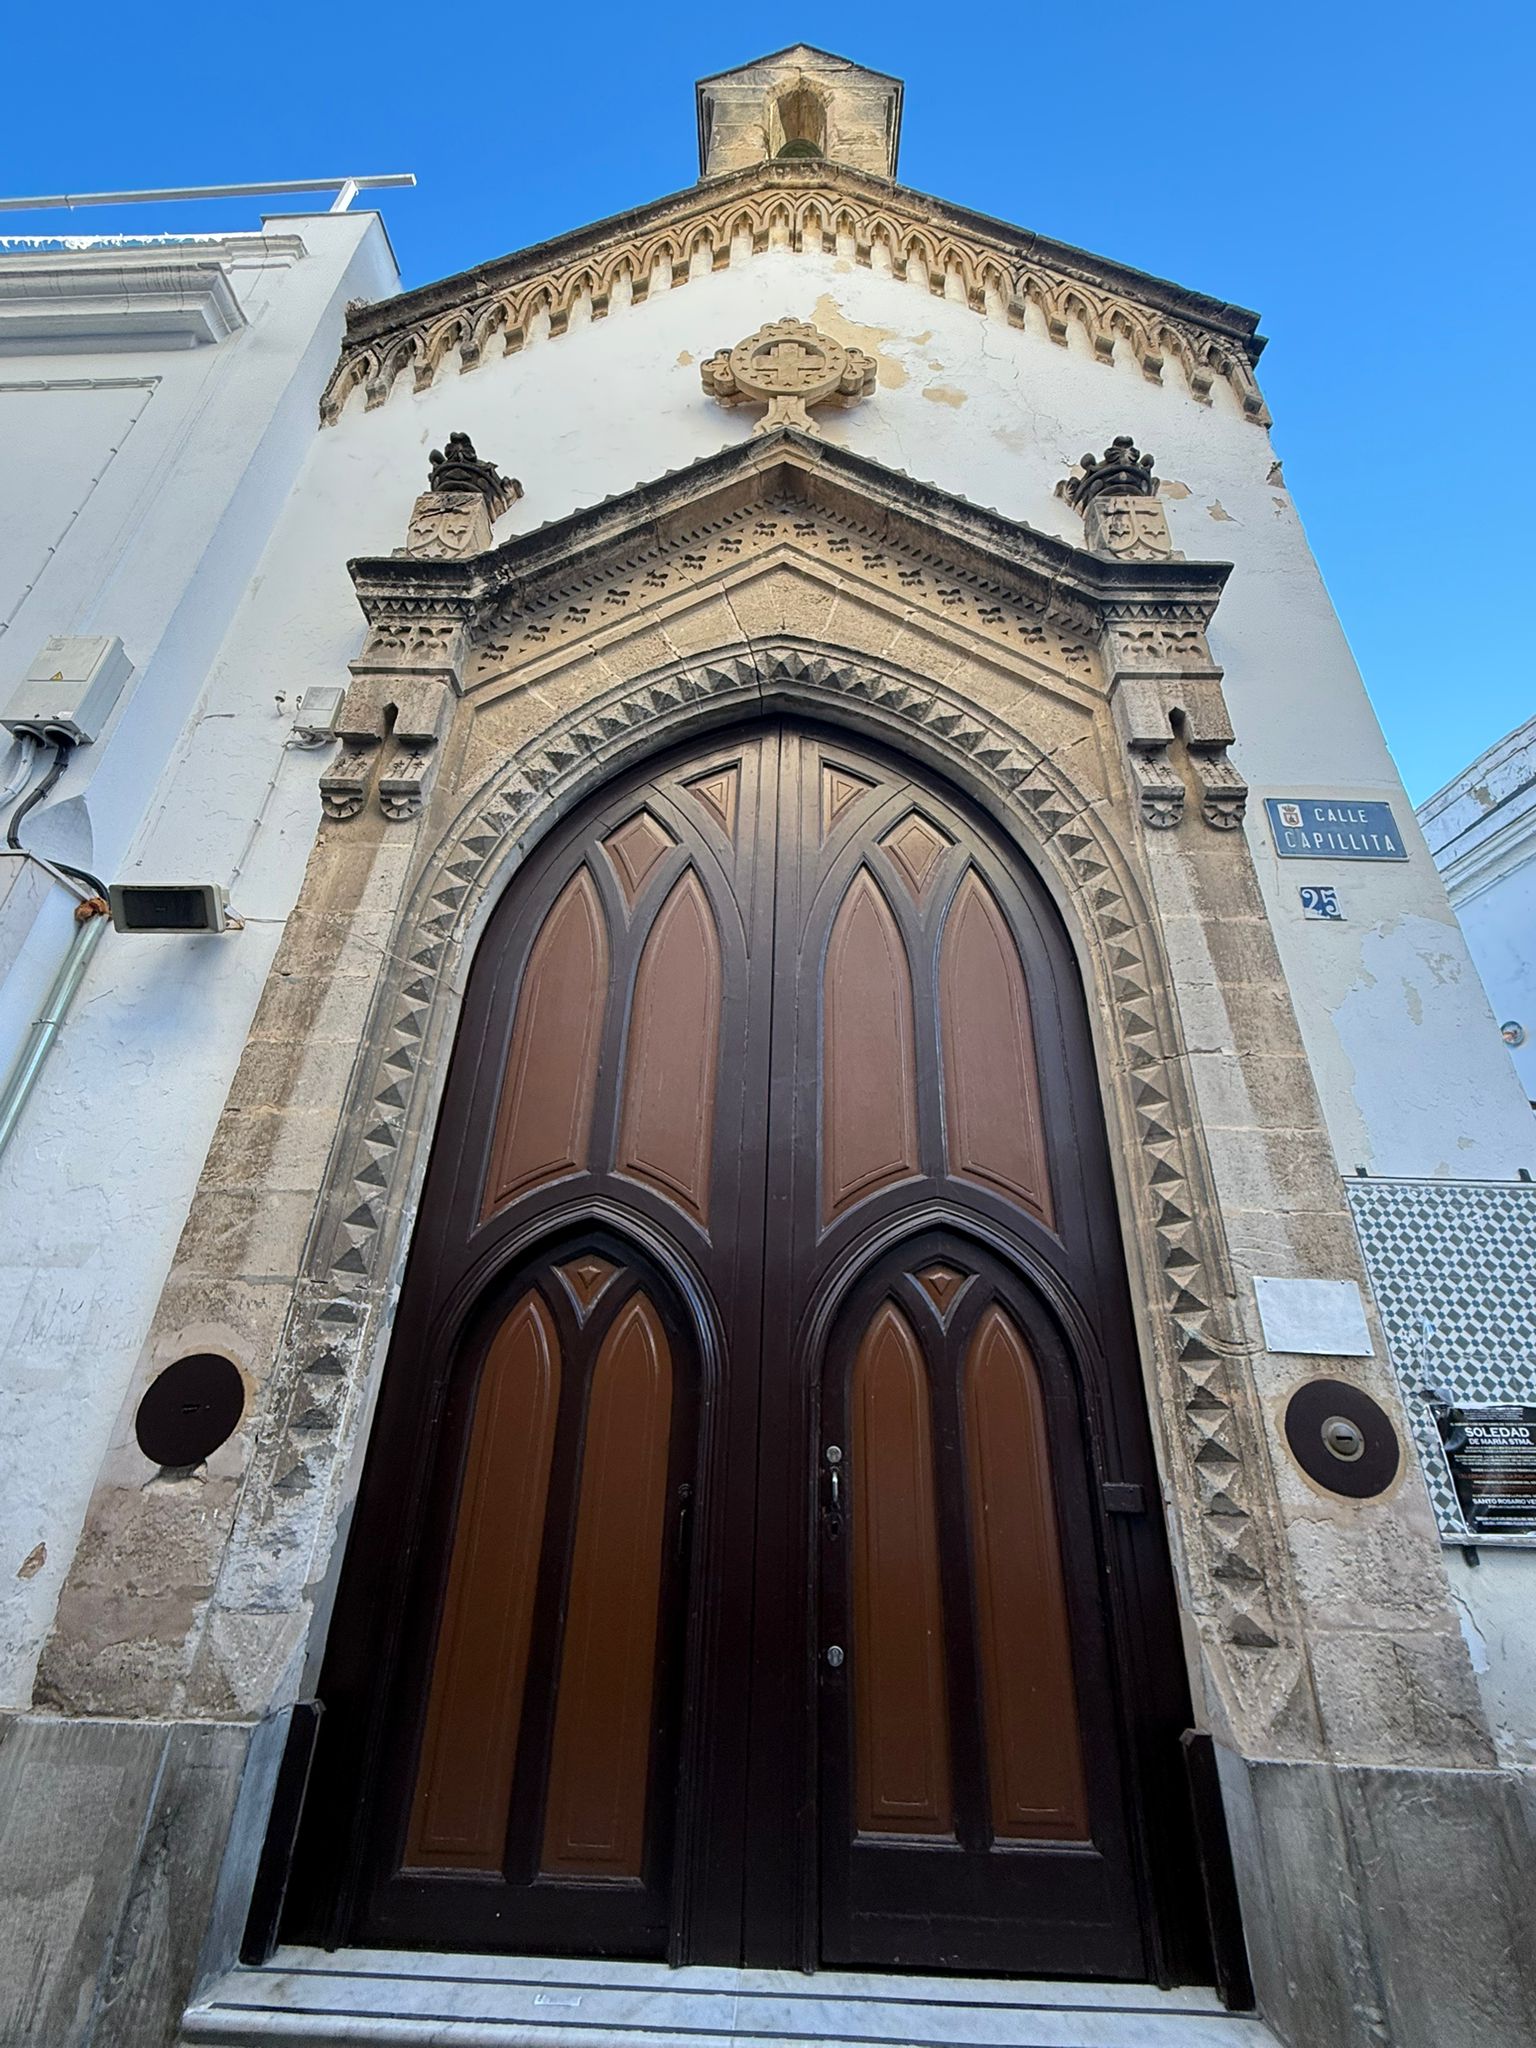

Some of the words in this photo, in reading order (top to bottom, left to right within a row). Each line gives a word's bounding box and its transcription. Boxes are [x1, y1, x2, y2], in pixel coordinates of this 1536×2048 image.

[1314, 808, 1368, 823] CALLE
[1284, 831, 1396, 852] CAPILLITA
[1301, 888, 1341, 918] 25
[1464, 1427, 1530, 1438] SOLEDAD
